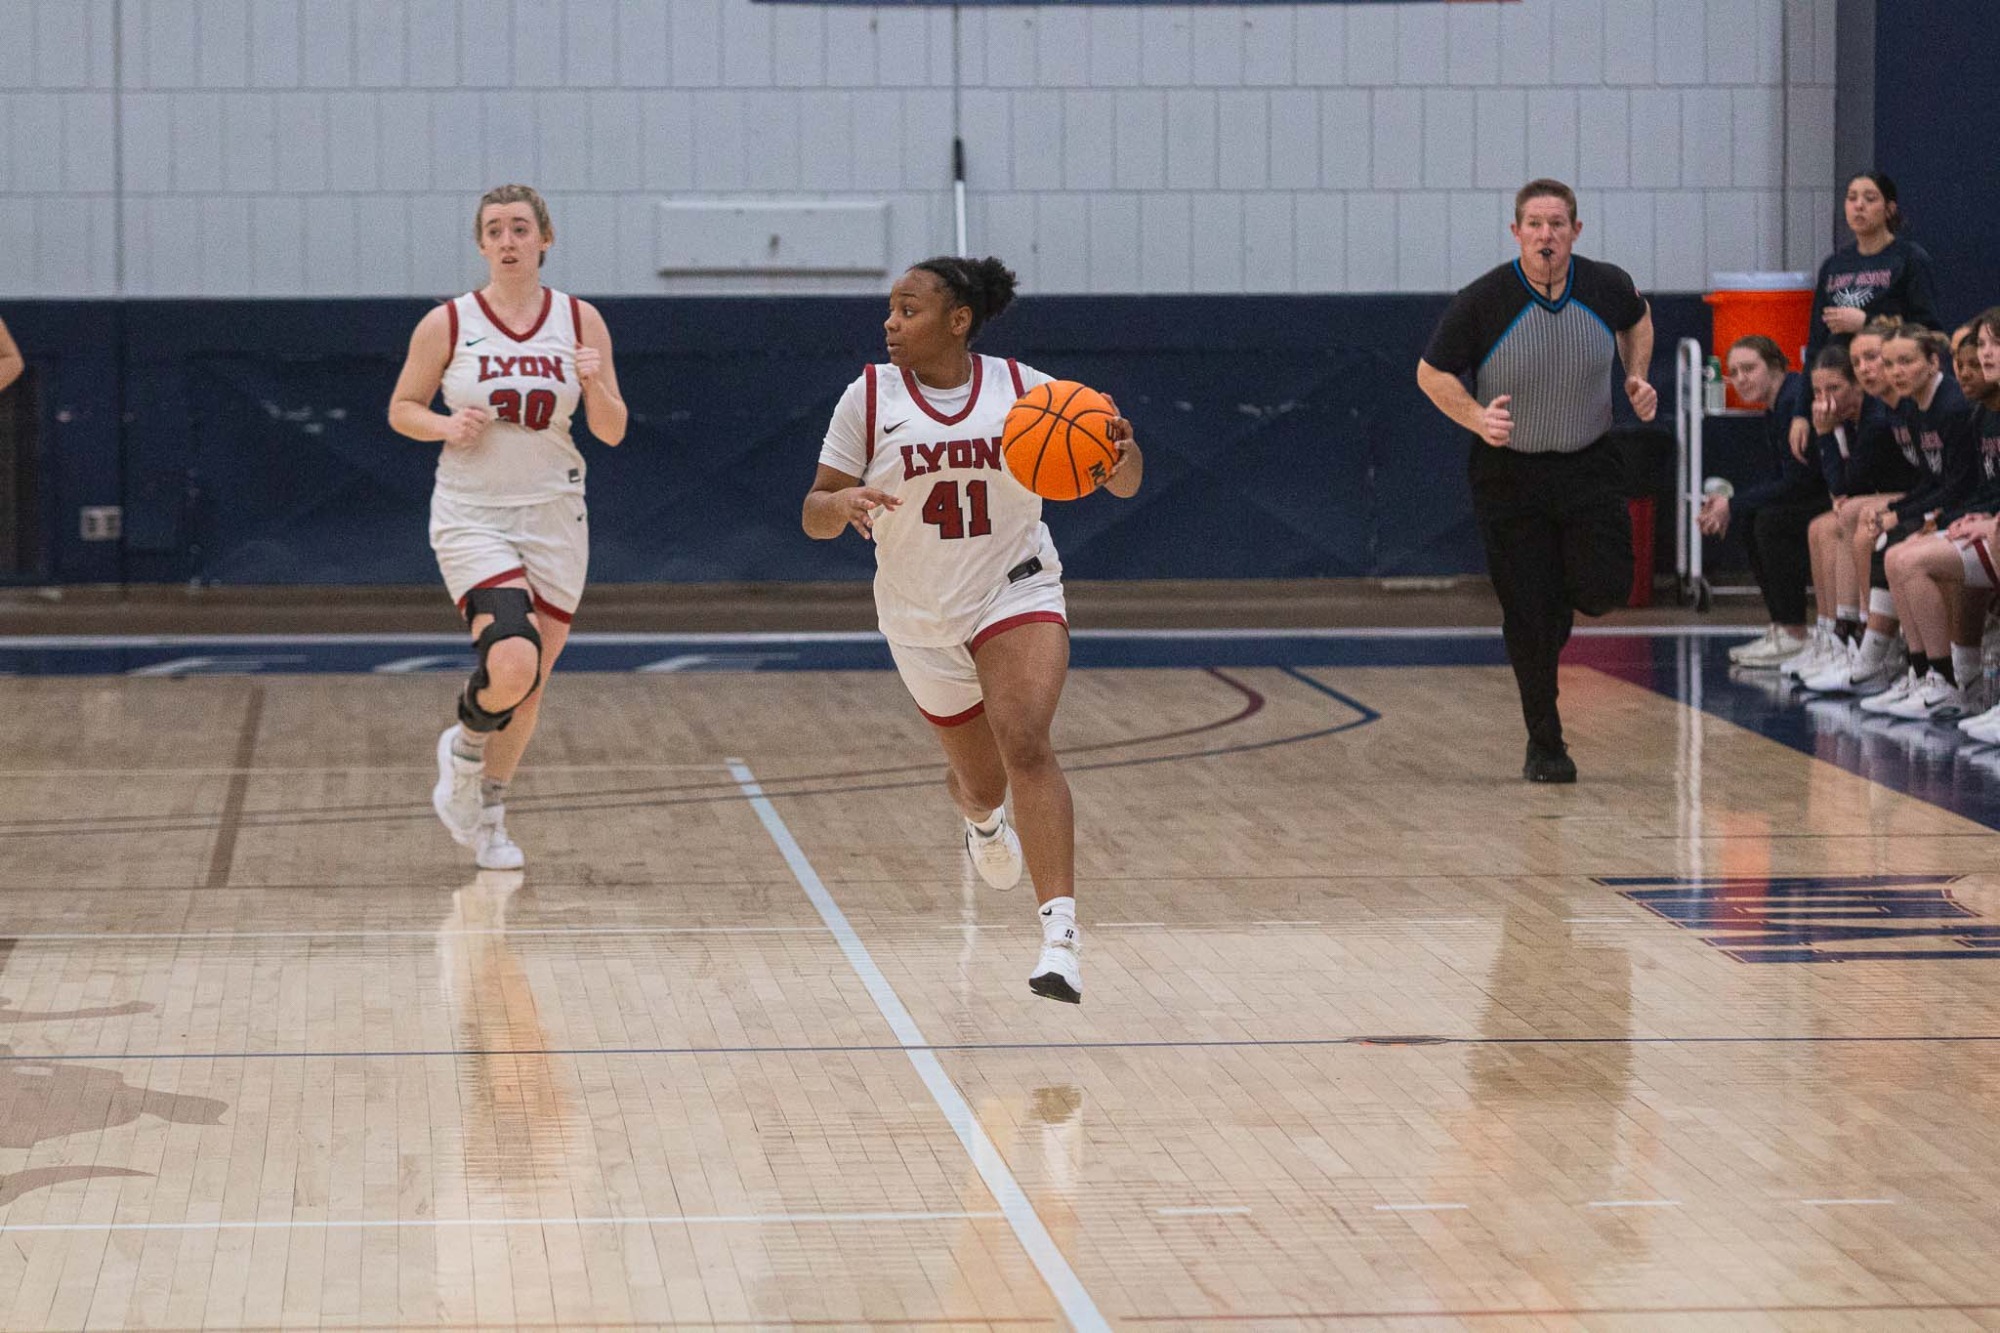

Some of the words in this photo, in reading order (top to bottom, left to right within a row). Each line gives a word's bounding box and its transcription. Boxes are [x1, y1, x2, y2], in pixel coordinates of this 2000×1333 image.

[478, 355, 566, 384] LYON
[489, 388, 557, 431] 30
[900, 436, 1002, 481] LYON
[922, 480, 992, 540] 41
